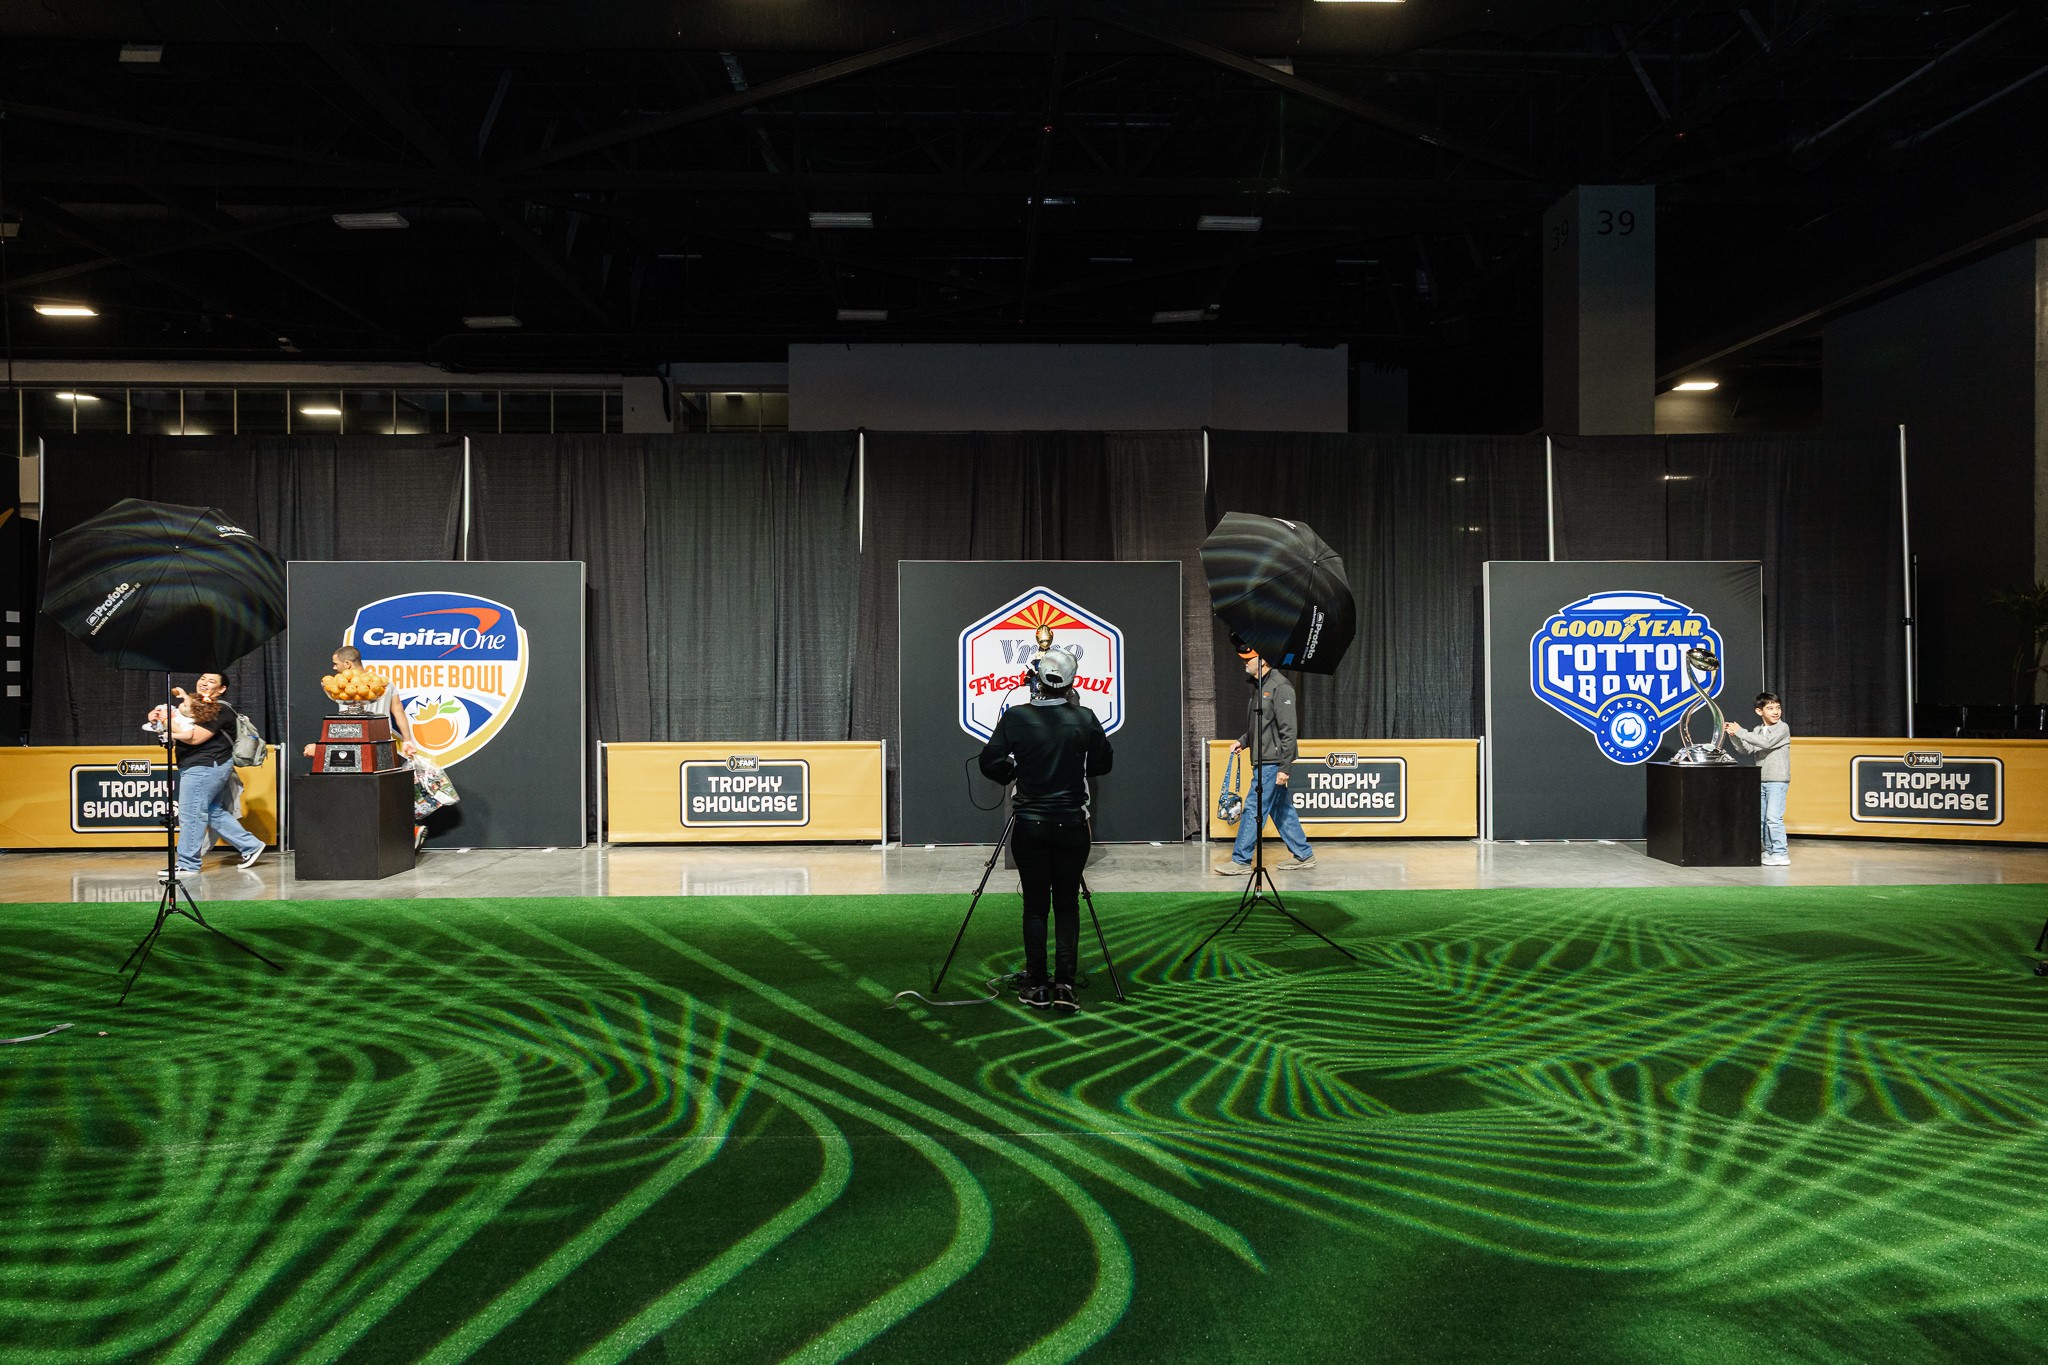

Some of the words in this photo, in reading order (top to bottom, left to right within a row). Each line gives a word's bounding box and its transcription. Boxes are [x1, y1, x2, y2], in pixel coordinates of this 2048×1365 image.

[1598, 210, 1635, 235] 39
[1552, 220, 1569, 252] 39
[94, 583, 130, 617] Profoto
[1307, 623, 1323, 659] Profoto
[1548, 643, 1707, 693] COTTON
[448, 665, 507, 698] BOWL
[969, 670, 1026, 697] Fiest
[1072, 675, 1114, 695] owl
[1578, 674, 1679, 705] BOWL
[1601, 700, 1656, 723] CLASSIC
[1603, 741, 1626, 759] EST.
[1631, 740, 1654, 759] 1937
[707, 776, 783, 793] TROPHY
[1307, 772, 1381, 790] TROPHY
[1881, 771, 1971, 790] TROPHY
[692, 795, 798, 813] SHOWCASE
[1292, 791, 1395, 809] SHOWCASE
[1864, 791, 1989, 811] SHOWCASE
